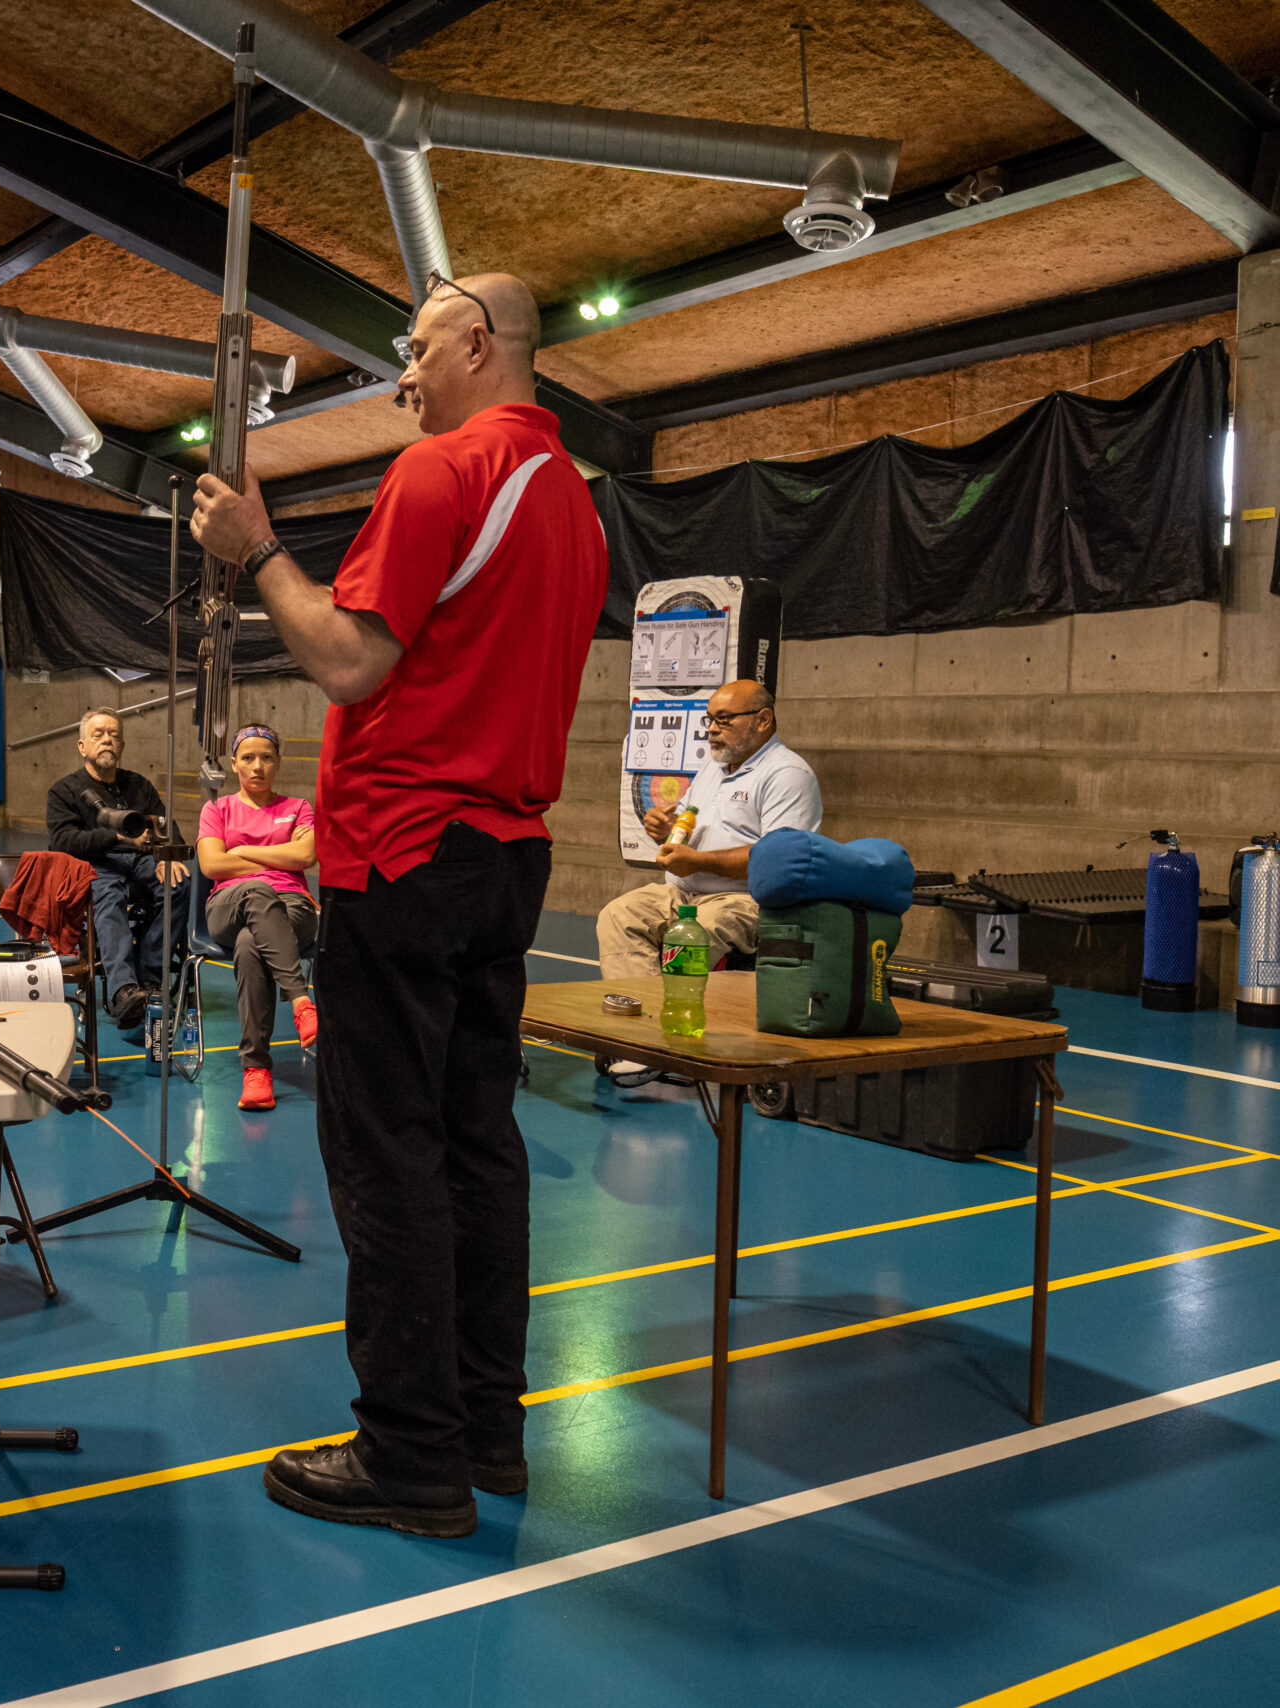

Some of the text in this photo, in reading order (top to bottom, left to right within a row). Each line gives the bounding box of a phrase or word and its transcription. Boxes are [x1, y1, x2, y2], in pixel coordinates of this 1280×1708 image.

[701, 620, 725, 628] Handling
[990, 925, 1006, 955] 2
[871, 939, 887, 1003] Caldwell
